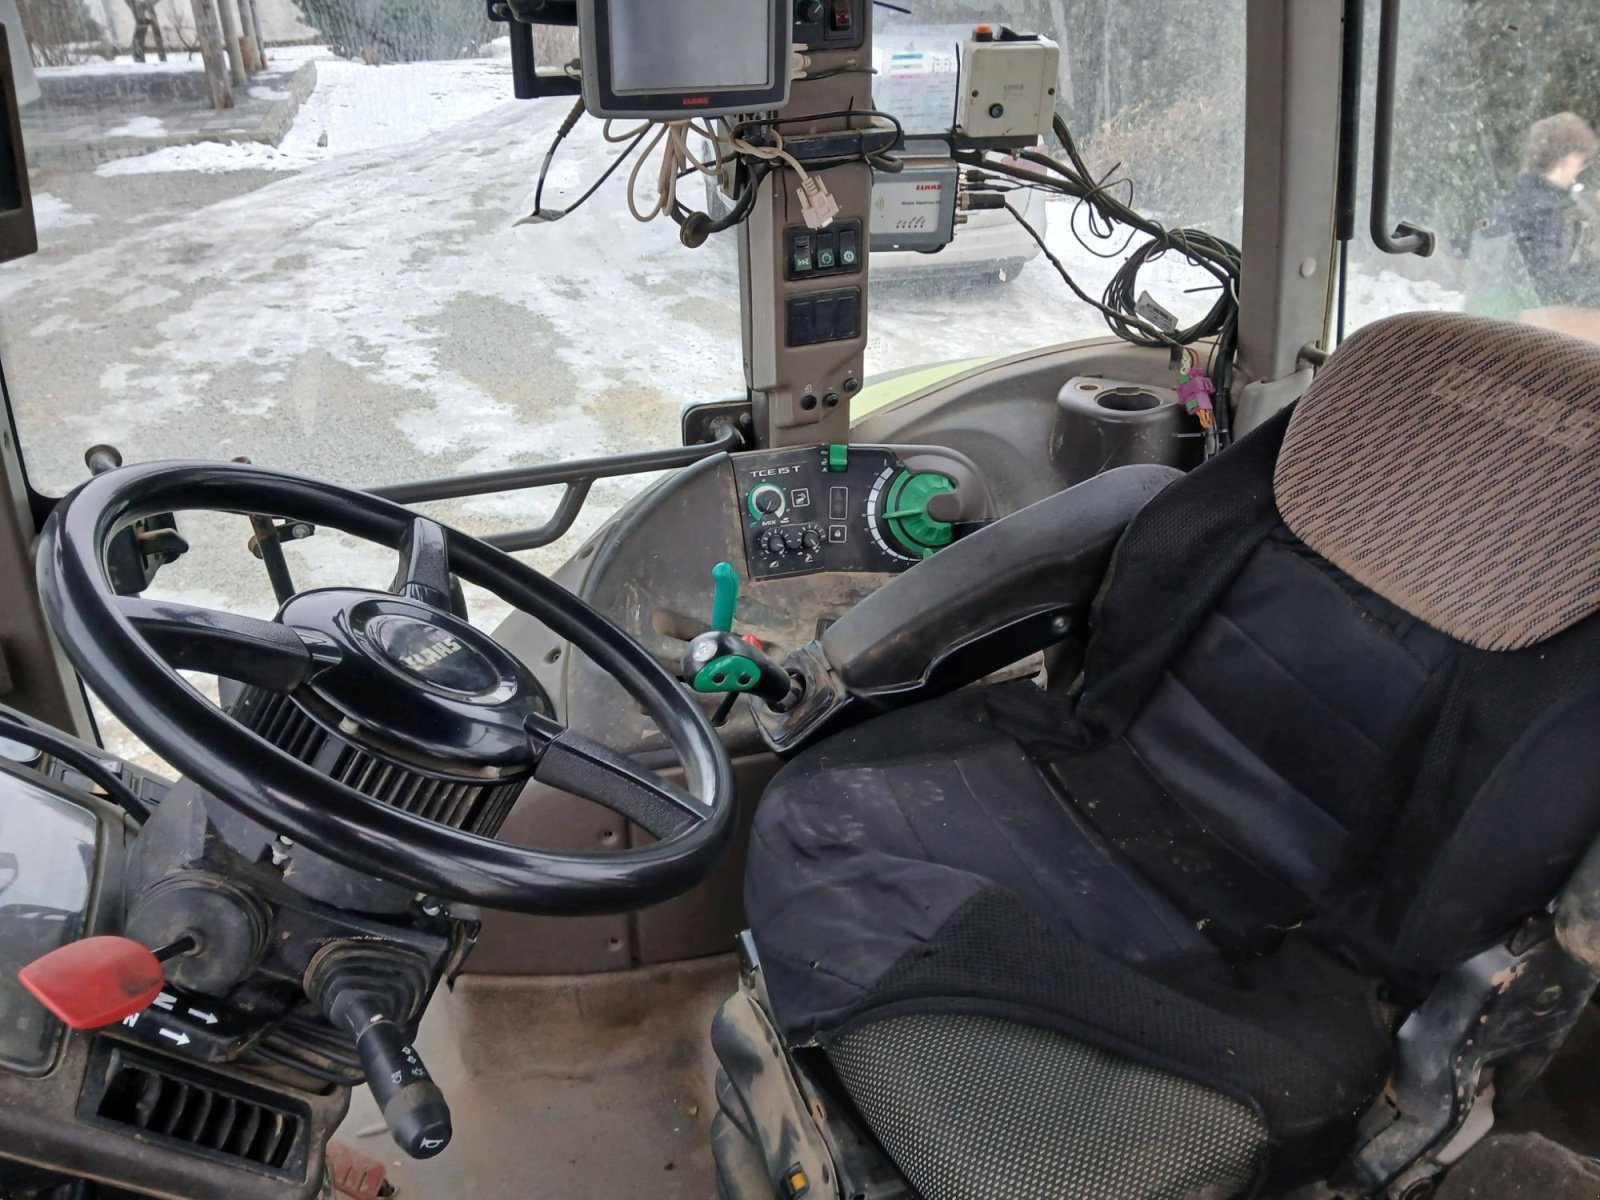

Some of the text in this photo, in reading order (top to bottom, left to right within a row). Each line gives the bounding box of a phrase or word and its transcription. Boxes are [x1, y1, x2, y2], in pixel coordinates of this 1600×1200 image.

[681, 96, 711, 105] CLAAS
[761, 519, 777, 527] MIX
[398, 636, 463, 672] CLAAS
